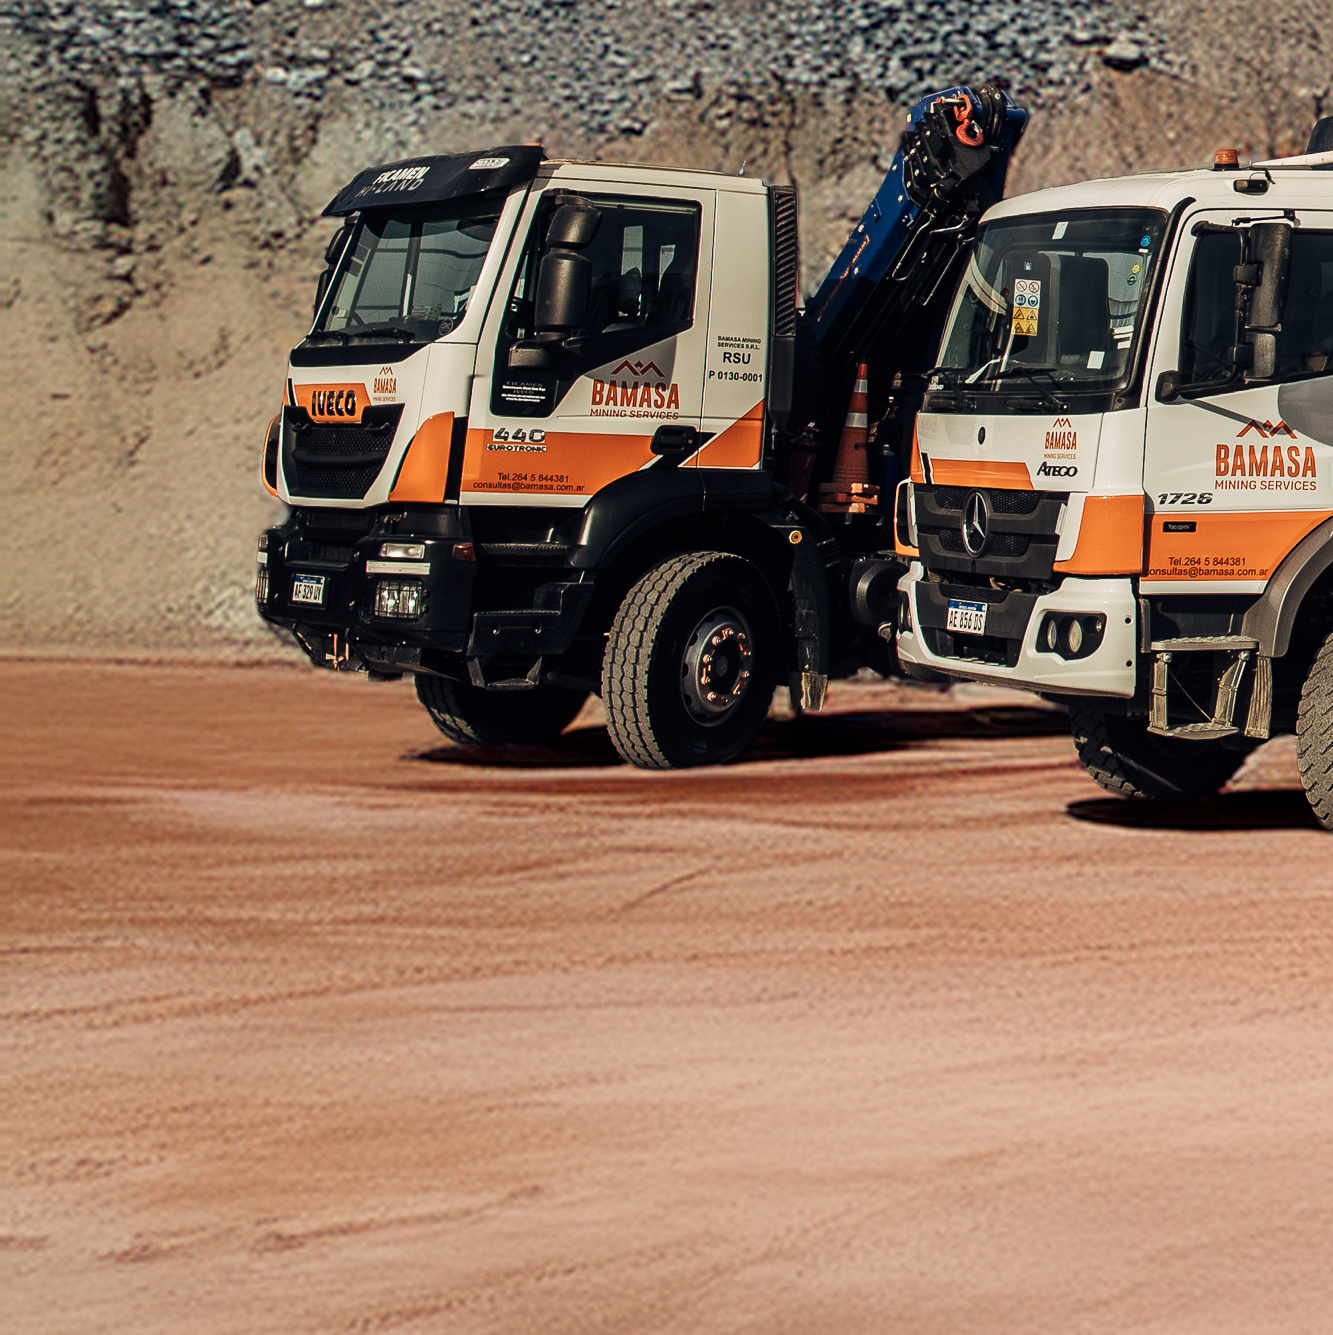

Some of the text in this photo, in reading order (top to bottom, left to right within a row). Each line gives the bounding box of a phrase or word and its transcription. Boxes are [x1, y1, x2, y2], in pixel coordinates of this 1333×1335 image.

[373, 166, 430, 185] FICAMEN
[355, 178, 425, 198] HI-LAND
[723, 352, 751, 365] RSU
[708, 370, 763, 383] P 0130-0001
[373, 378, 397, 394] BAMASA
[591, 378, 680, 410] BAMASA
[312, 390, 357, 417] IVECO
[590, 408, 680, 420] MINING SERVICES
[494, 427, 546, 443] 440
[1044, 431, 1077, 450] BAMASA
[487, 444, 547, 453] EUROTRONIC
[1215, 443, 1317, 478] BAMASA
[530, 473, 536, 482] 5
[538, 473, 569, 483] 844381
[473, 481, 585, 492] consultas@bamasa.com.ar
[1214, 480, 1317, 490] MINING SERVICES
[1157, 492, 1214, 505] 1726
[1168, 523, 1190, 531] Yacopini
[1204, 557, 1210, 566] 5
[1212, 557, 1246, 566] 844381
[1144, 566, 1268, 578] consultas@bamasa.com.ar
